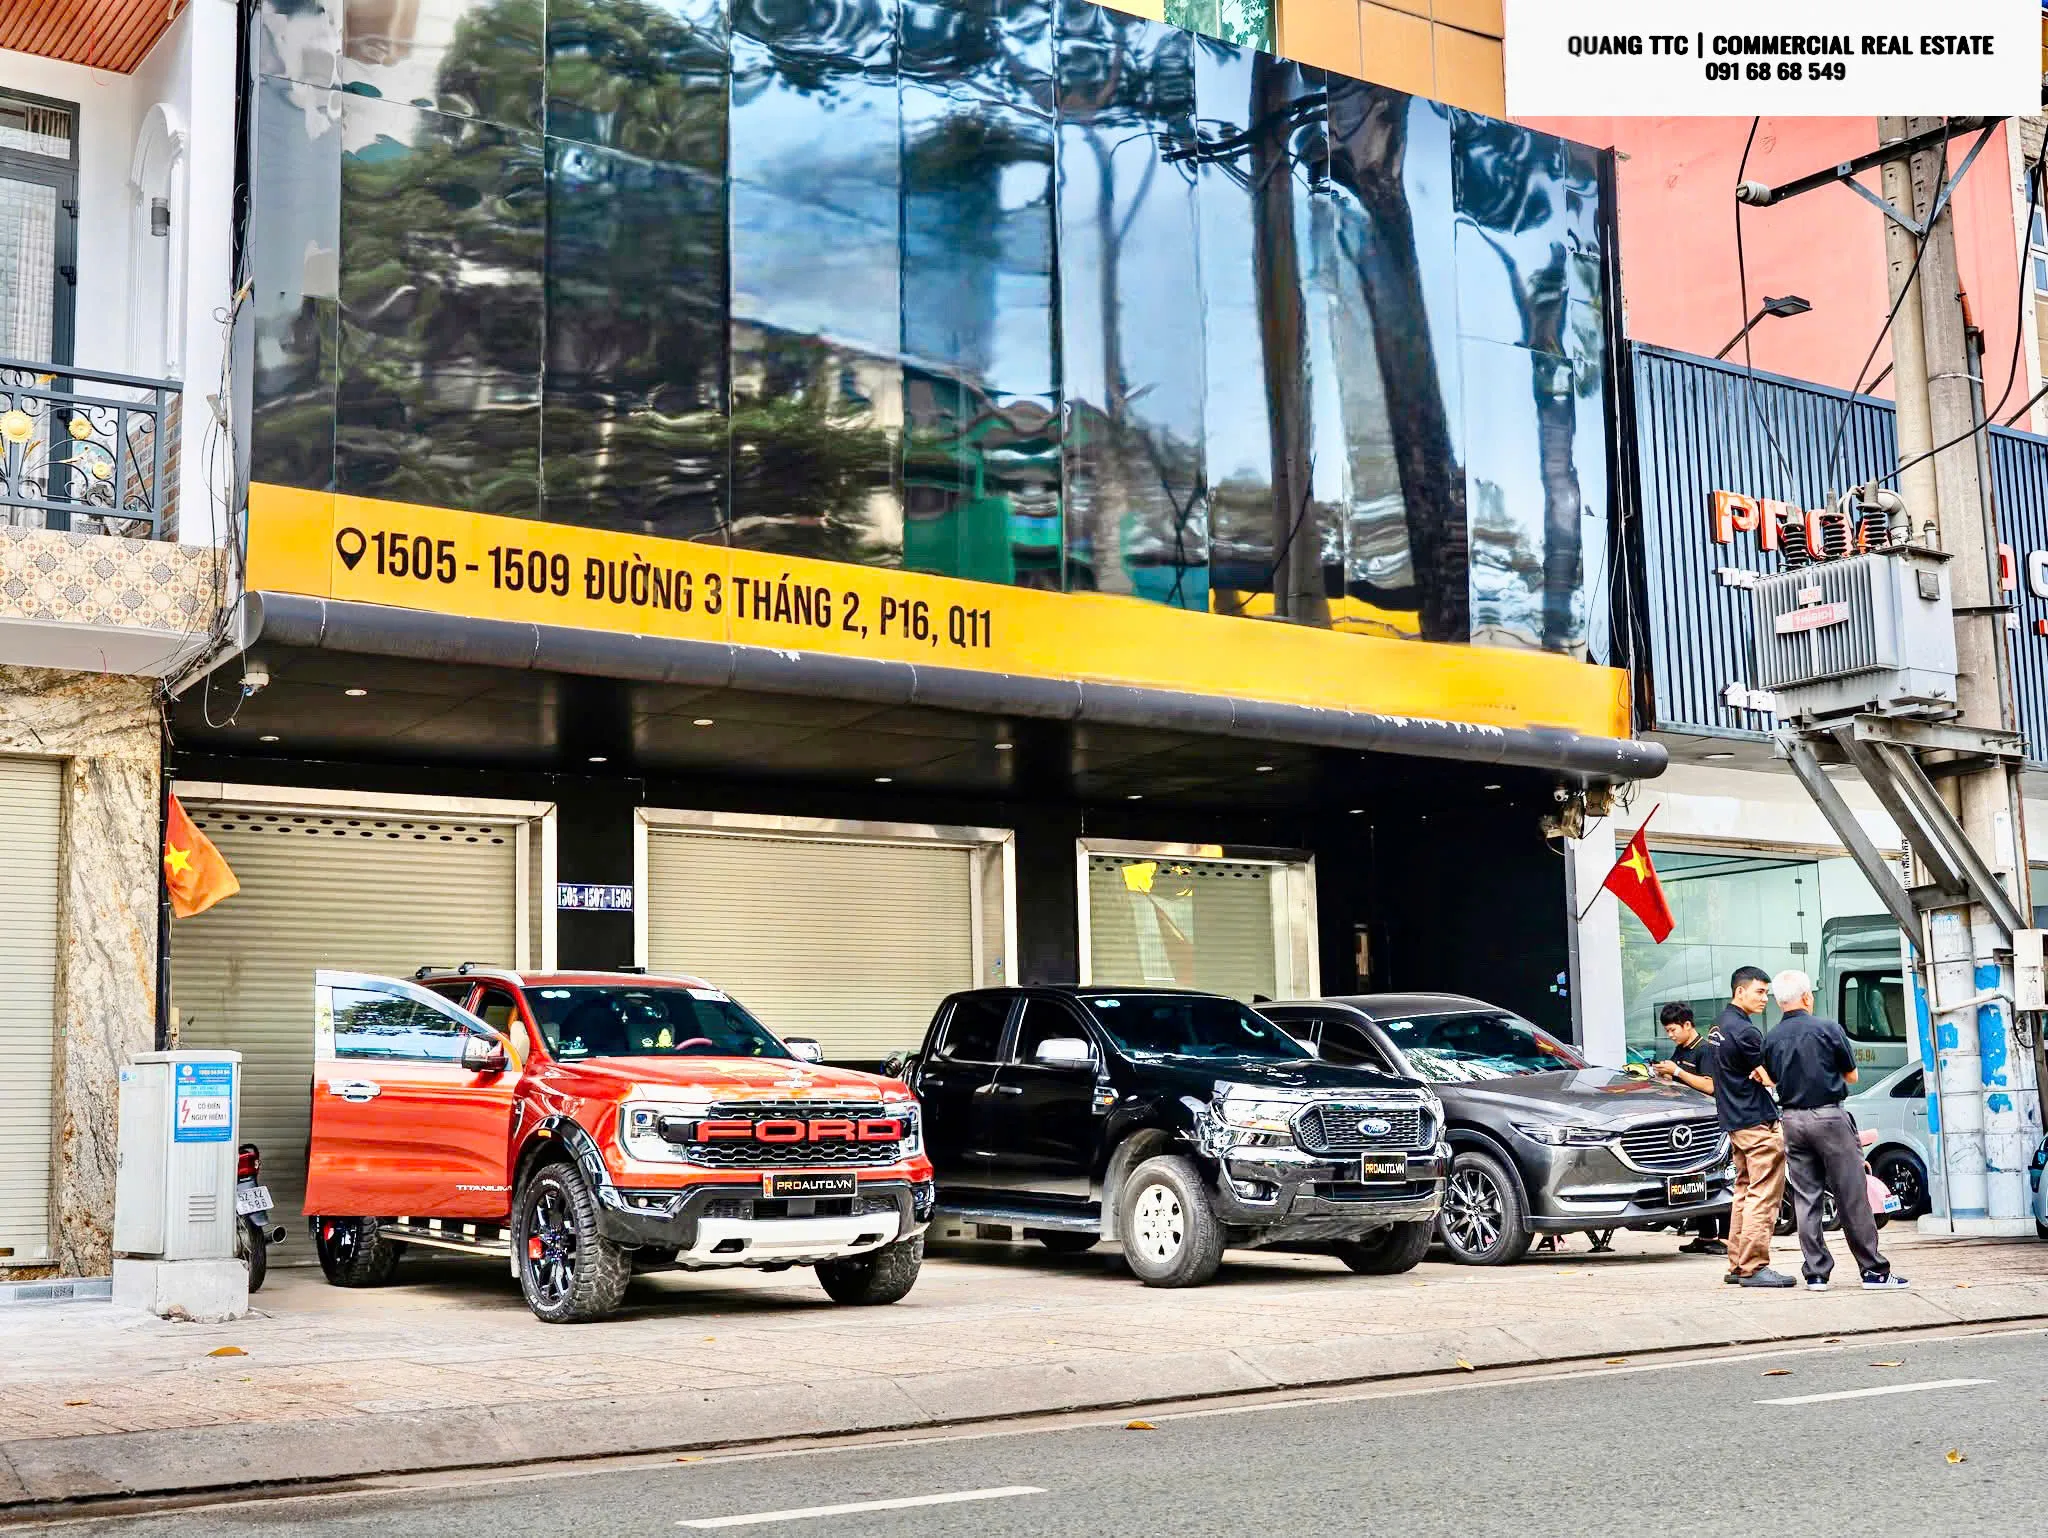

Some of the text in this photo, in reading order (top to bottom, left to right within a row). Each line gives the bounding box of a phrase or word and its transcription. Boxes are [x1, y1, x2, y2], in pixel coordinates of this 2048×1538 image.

[371, 531, 457, 584] 1505
[488, 546, 570, 597] 1509
[583, 552, 692, 612] ĐƯỜNG
[704, 573, 722, 615] 3
[732, 573, 832, 628] THÁNG
[842, 591, 869, 639] 2,
[880, 596, 939, 647] P16,
[949, 605, 990, 649] Q11
[697, 1119, 904, 1143] FORD
[456, 1184, 513, 1192] TITANIUM
[776, 1179, 852, 1190] PROAUTO.VN
